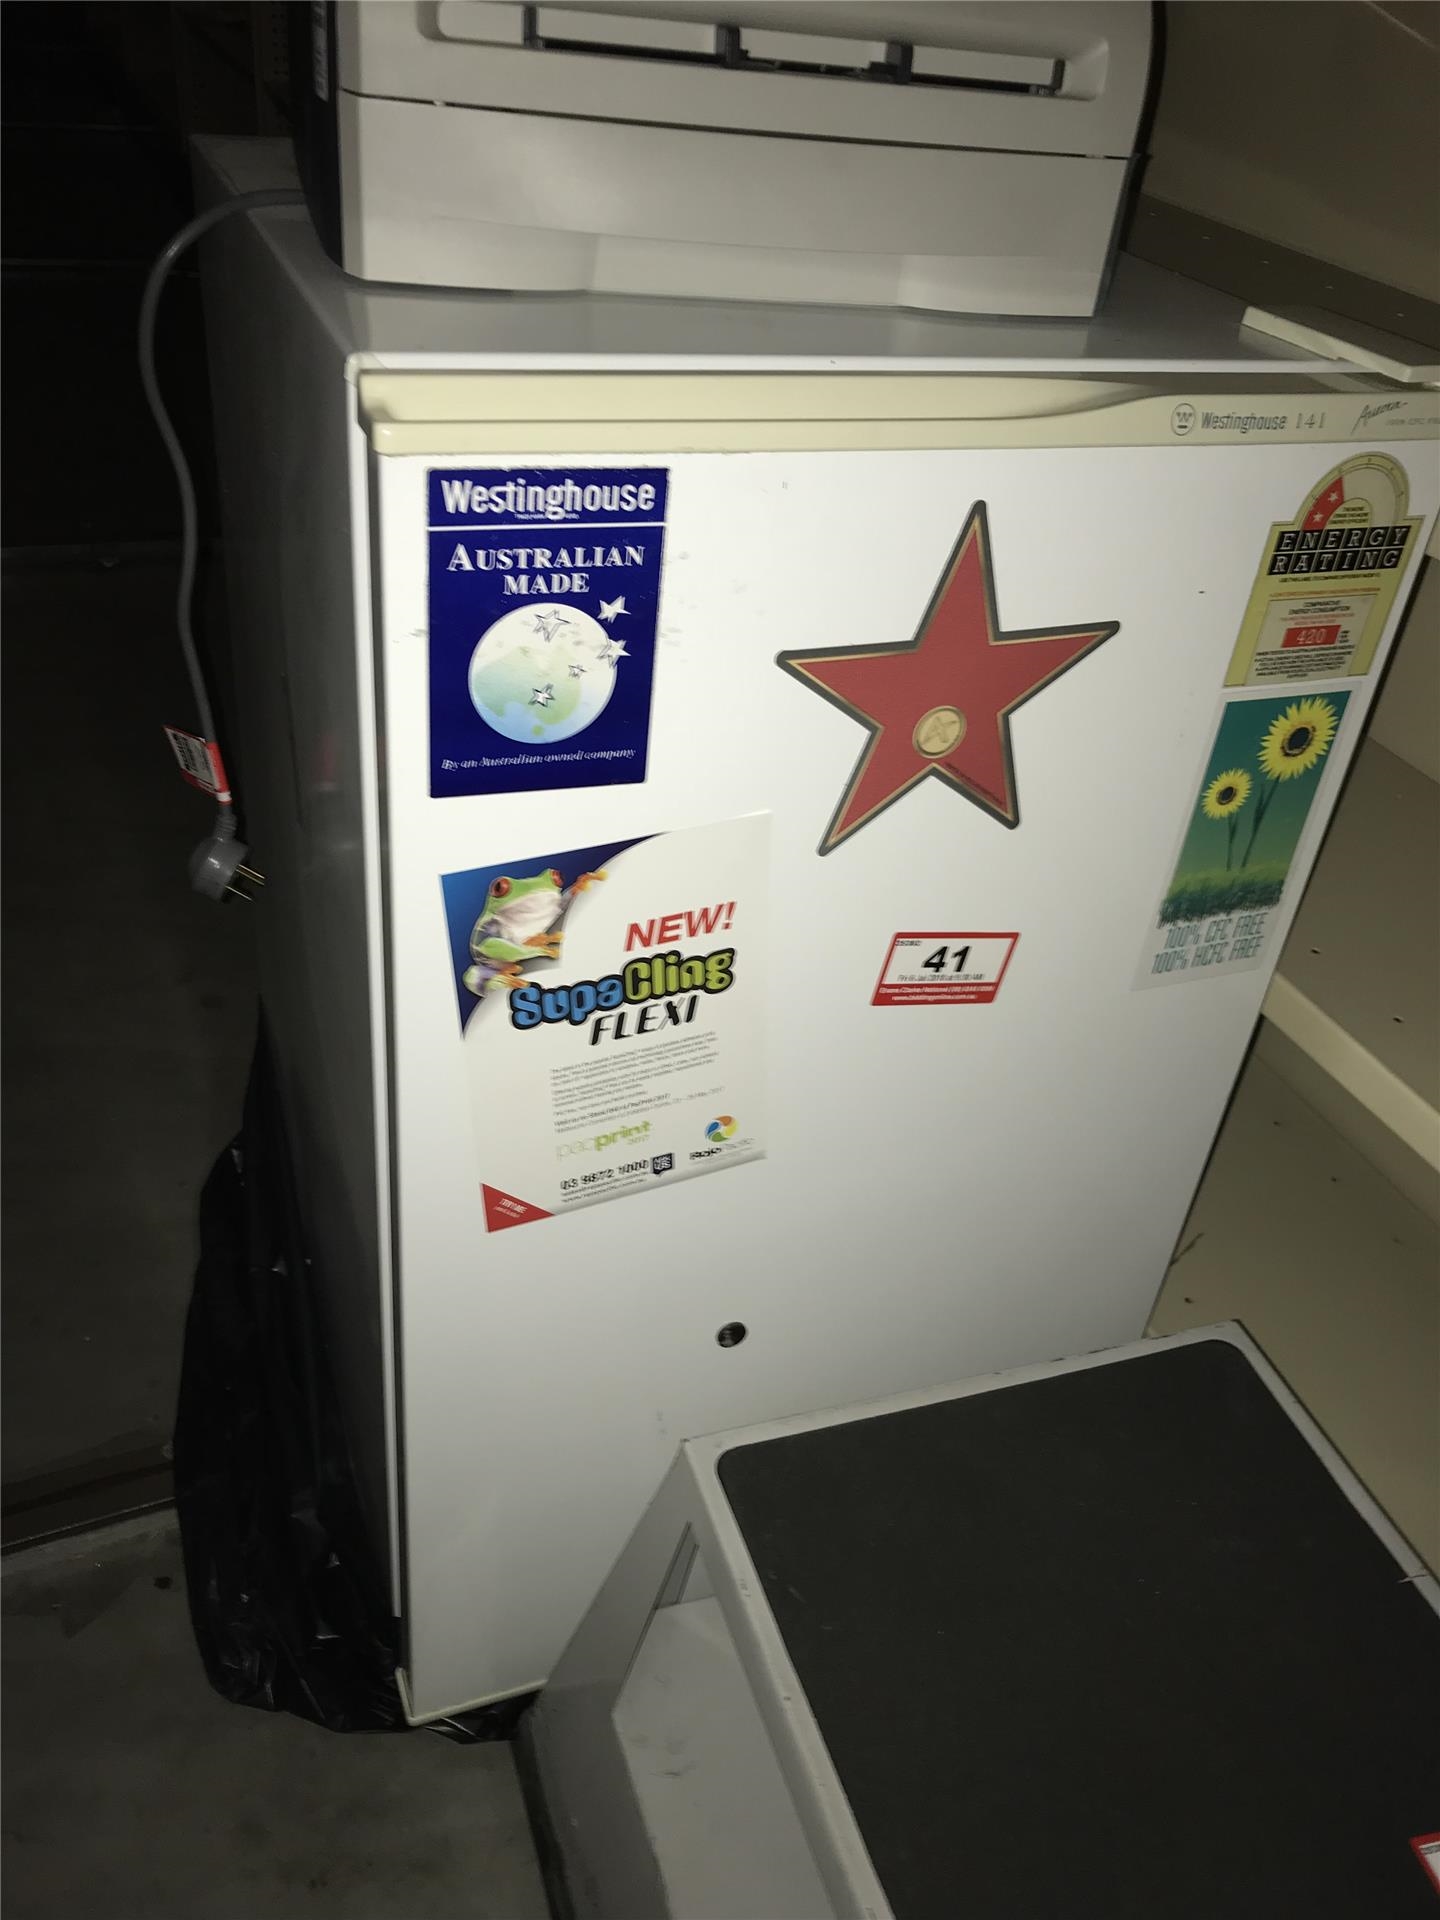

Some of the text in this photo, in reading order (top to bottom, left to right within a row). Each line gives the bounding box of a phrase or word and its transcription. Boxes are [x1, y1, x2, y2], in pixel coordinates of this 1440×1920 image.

[1201, 411, 1288, 434] Westinghouse
[441, 477, 656, 520] Westinghouse
[1280, 526, 1409, 551] ENERGY
[446, 543, 646, 572] AUSTRALIAN
[1271, 550, 1399, 574] RATING
[502, 572, 590, 596] MADE
[1297, 628, 1327, 645] 420
[623, 901, 737, 951] NEW!
[1233, 911, 1269, 938] FREE
[921, 945, 972, 973] 41
[588, 995, 700, 1046] FLEXI
